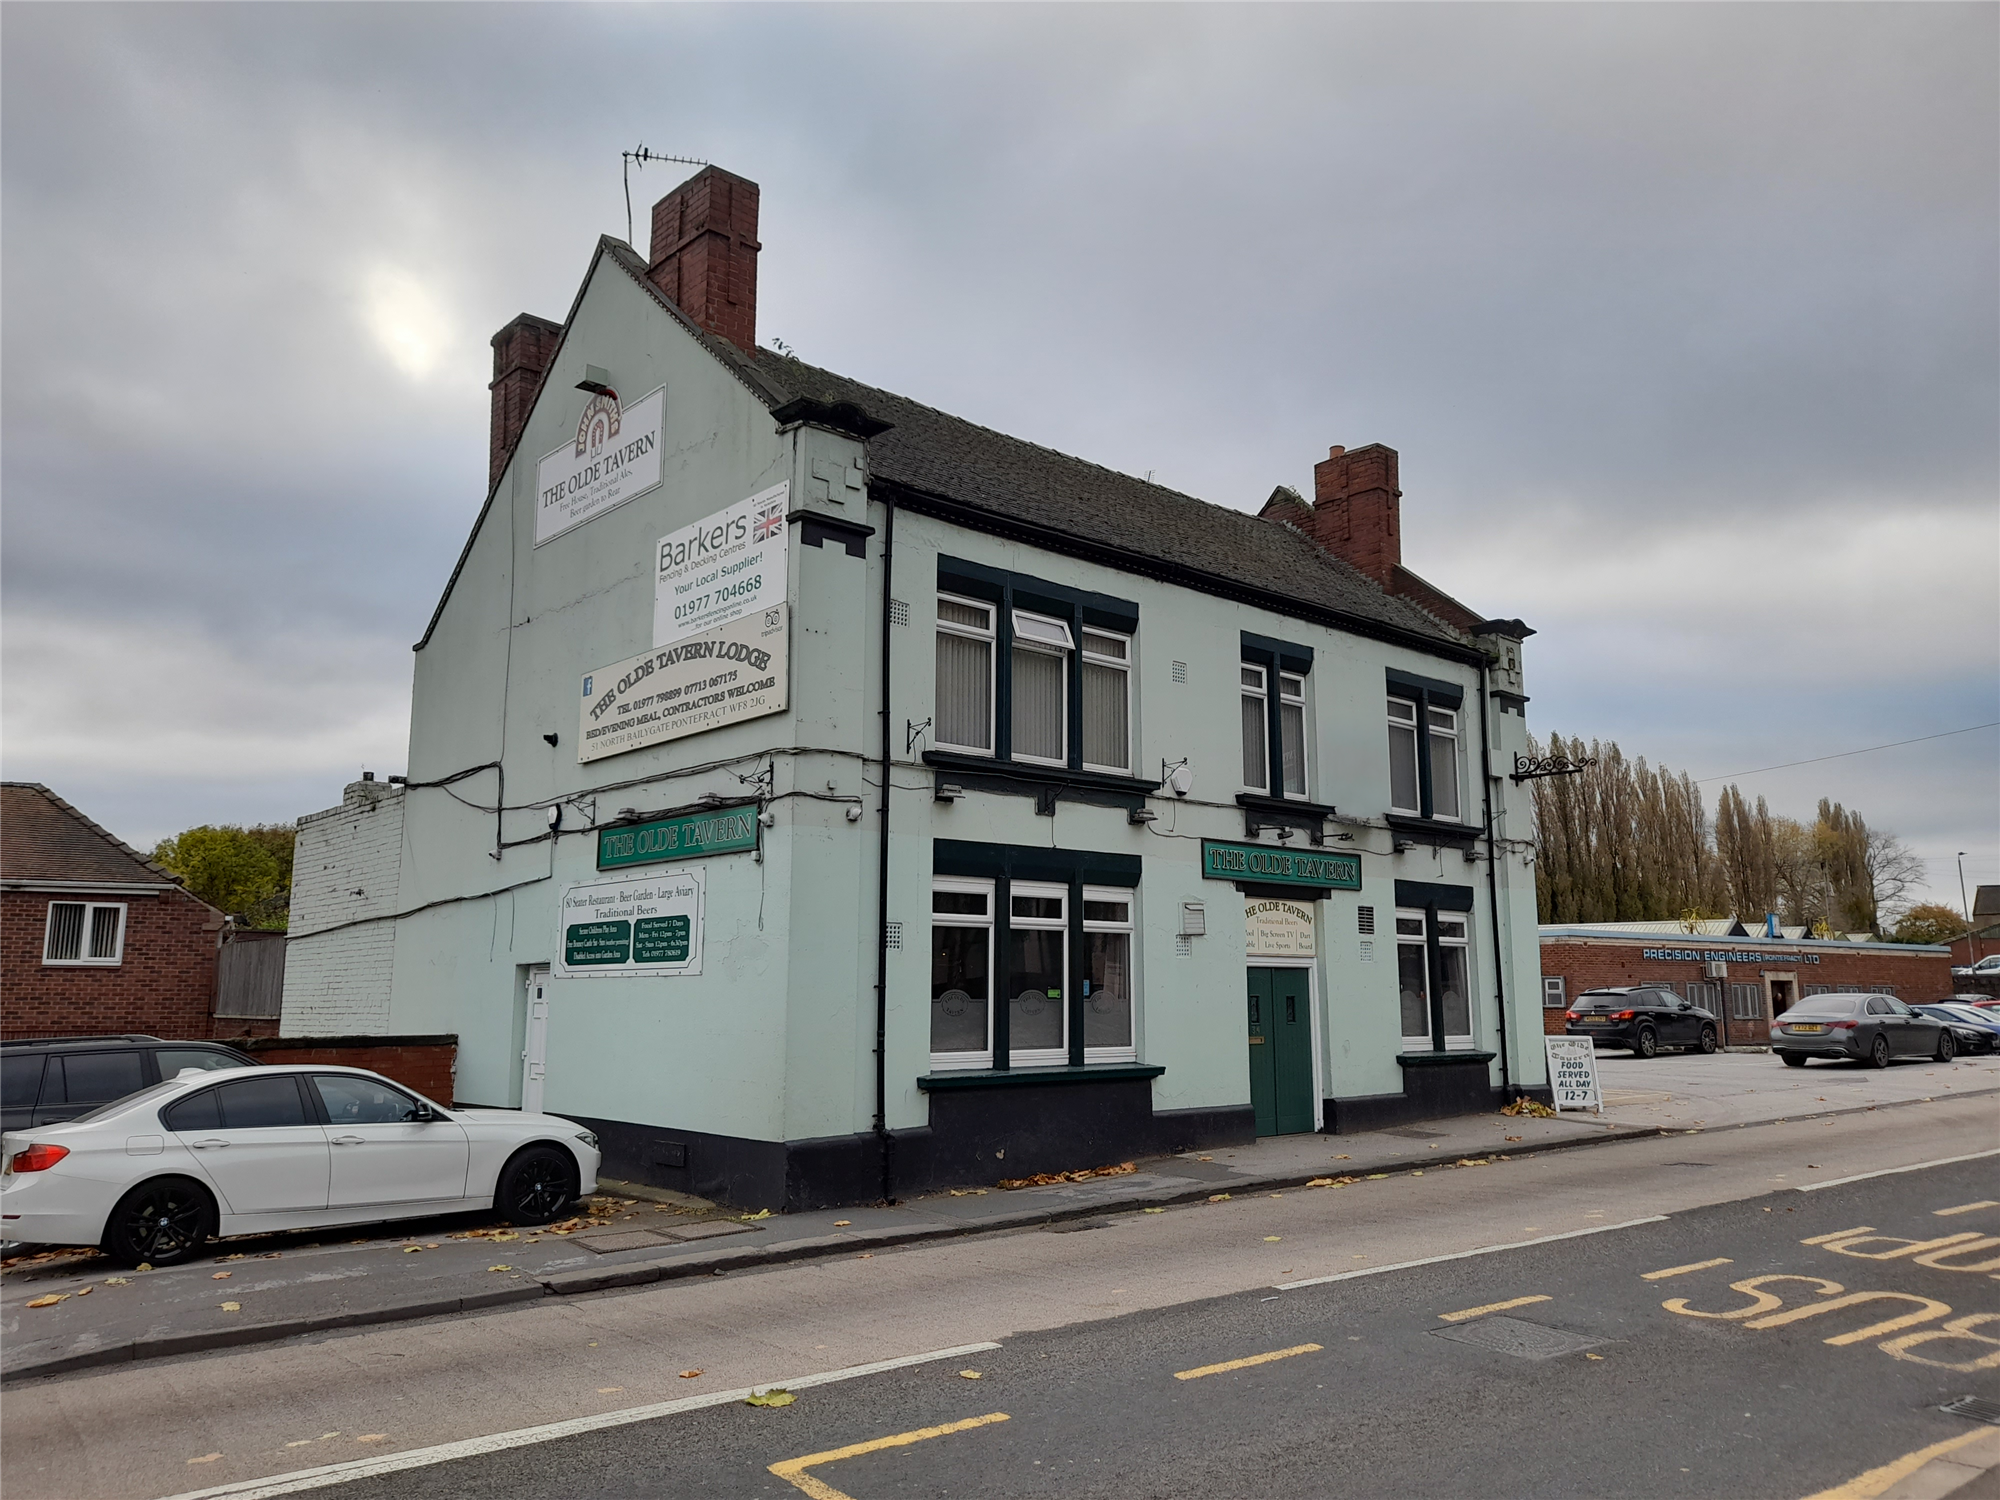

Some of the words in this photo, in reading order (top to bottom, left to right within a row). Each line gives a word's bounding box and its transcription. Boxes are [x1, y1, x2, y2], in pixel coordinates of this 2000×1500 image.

[577, 403, 595, 452] JOHN
[542, 481, 566, 509] THE
[568, 461, 600, 494] OLDE
[603, 430, 656, 476] TAVERN
[560, 502, 570, 512] Free
[590, 474, 620, 496] Traditional
[570, 508, 582, 519] Beer
[582, 499, 600, 514] garden
[601, 495, 608, 503] to
[608, 487, 621, 500] Rear
[660, 514, 746, 572] Barkers
[660, 568, 683, 584] Fencing
[684, 564, 690, 573] &
[691, 552, 718, 570] Decking
[720, 541, 746, 559] Centres
[674, 581, 694, 596] Your
[696, 570, 719, 588] Local
[721, 552, 763, 578] Supplier!
[674, 594, 710, 620] 01977
[714, 574, 762, 605] 704668
[678, 594, 758, 628] www.barkersfencingonline.co.uk
[714, 613, 729, 624] online
[730, 608, 743, 619] shop
[590, 688, 616, 721] THE
[617, 658, 654, 694] OLDE
[656, 641, 717, 670] TAVERN
[716, 641, 772, 672] LODGE
[586, 718, 635, 740] BED/EVENING
[636, 711, 662, 726] MEAL,
[662, 690, 726, 718] CONTRACTORS
[727, 676, 776, 699] WELCOME
[617, 702, 632, 716] TEL
[633, 696, 654, 710] 01977
[684, 679, 706, 696] 07713
[600, 734, 626, 749] NORTH
[626, 720, 670, 742] BAILYGATE
[671, 705, 728, 730] PONTEFRACT
[730, 700, 748, 713] WF8
[750, 695, 766, 708] 2JG
[604, 833, 634, 858] THE
[637, 826, 679, 854] OLDE
[682, 812, 752, 847] TAVERN
[1210, 848, 1247, 871] THE
[1249, 852, 1293, 876] OLDE
[1295, 856, 1357, 881] TAVERN
[588, 894, 616, 906] Restaurant
[620, 890, 632, 902] Beer
[633, 888, 654, 902] Garden
[658, 886, 674, 900] Large
[674, 884, 694, 898] Aviary
[595, 905, 635, 919] Traditional
[636, 904, 658, 916] Beers
[641, 920, 652, 929] Food
[1245, 905, 1258, 918] HE
[1258, 901, 1280, 912] OLDE
[1281, 902, 1312, 925] TAVERN
[1256, 916, 1284, 925] Traditional
[1284, 918, 1298, 926] Beers
[1260, 930, 1268, 938] Big
[1270, 930, 1286, 938] Screen
[1264, 940, 1274, 948] Live
[1276, 942, 1290, 950] Sports
[1643, 949, 1700, 960] PRECISION
[1704, 952, 1762, 962] ENGINEERS
[1804, 954, 1820, 964] LTD
[1558, 1070, 1590, 1079] SERVED
[1561, 1062, 1584, 1070] FOOD
[1565, 1090, 1588, 1100] 12-7
[1576, 1080, 1591, 1088] DAY
